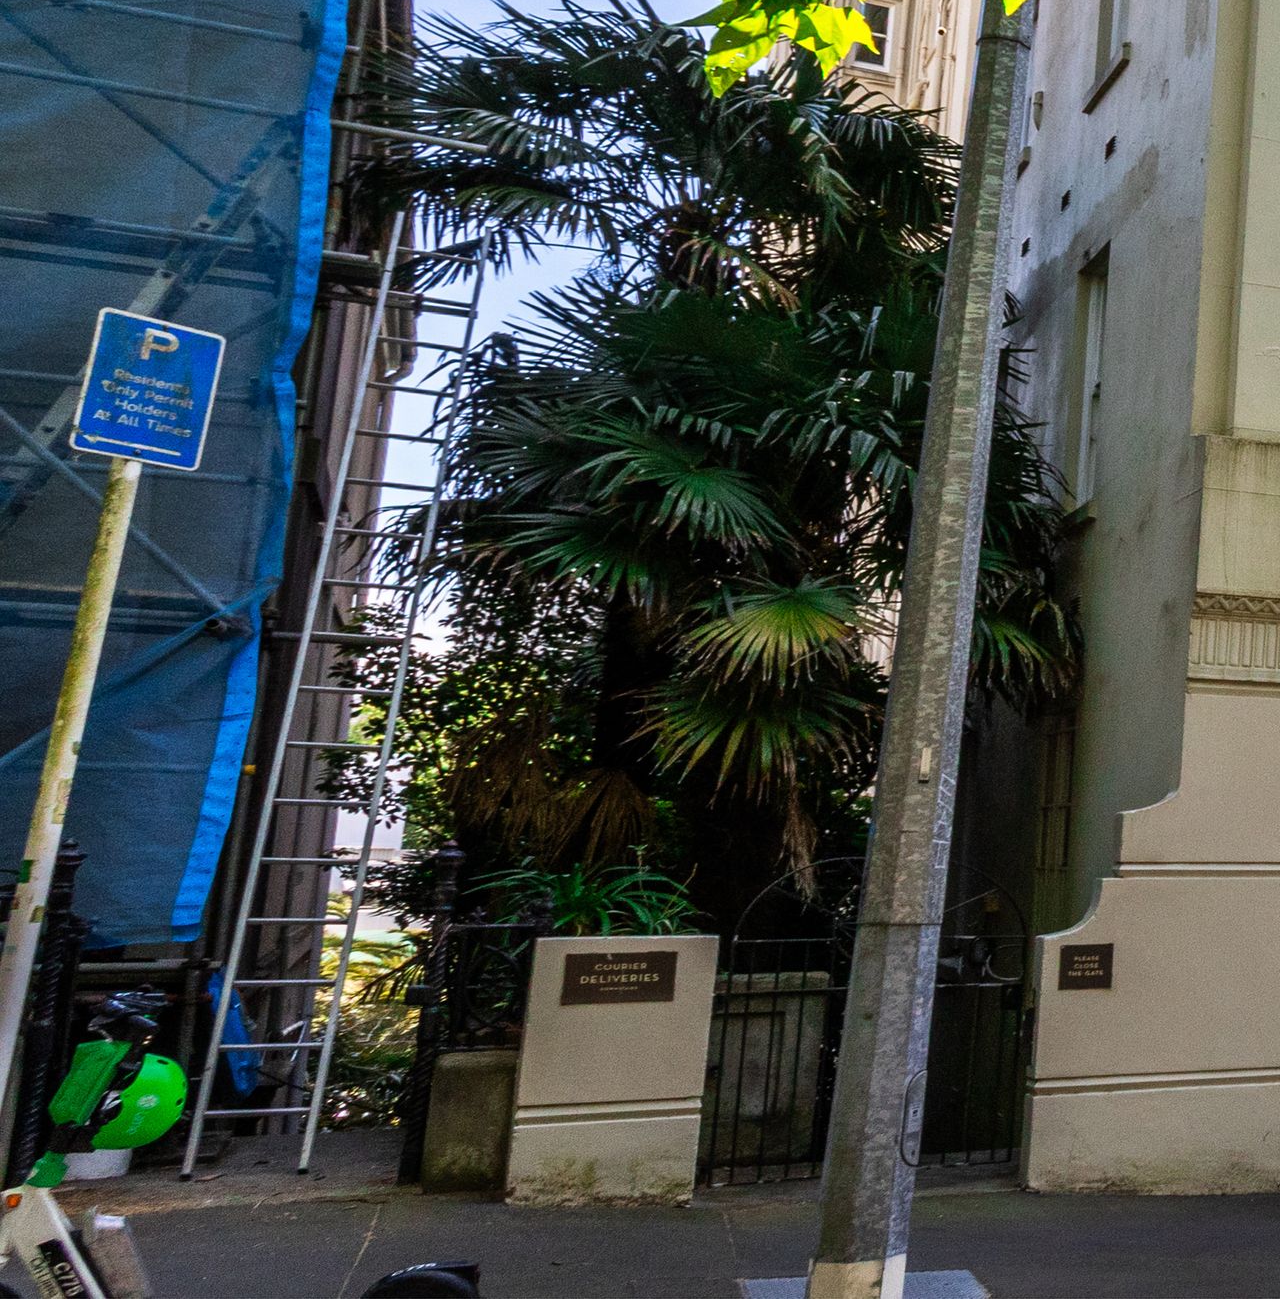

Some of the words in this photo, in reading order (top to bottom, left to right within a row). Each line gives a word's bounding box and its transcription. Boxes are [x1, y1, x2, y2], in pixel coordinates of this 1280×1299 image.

[140, 328, 179, 361] P
[101, 380, 139, 399] Only
[144, 389, 194, 410] Permit
[114, 368, 191, 395] Residents
[115, 398, 177, 421] Holders
[93, 409, 112, 421] At
[117, 414, 139, 428] All
[148, 419, 193, 438] Times
[580, 973, 660, 985] DELIVERIES
[594, 962, 648, 971] COURIER
